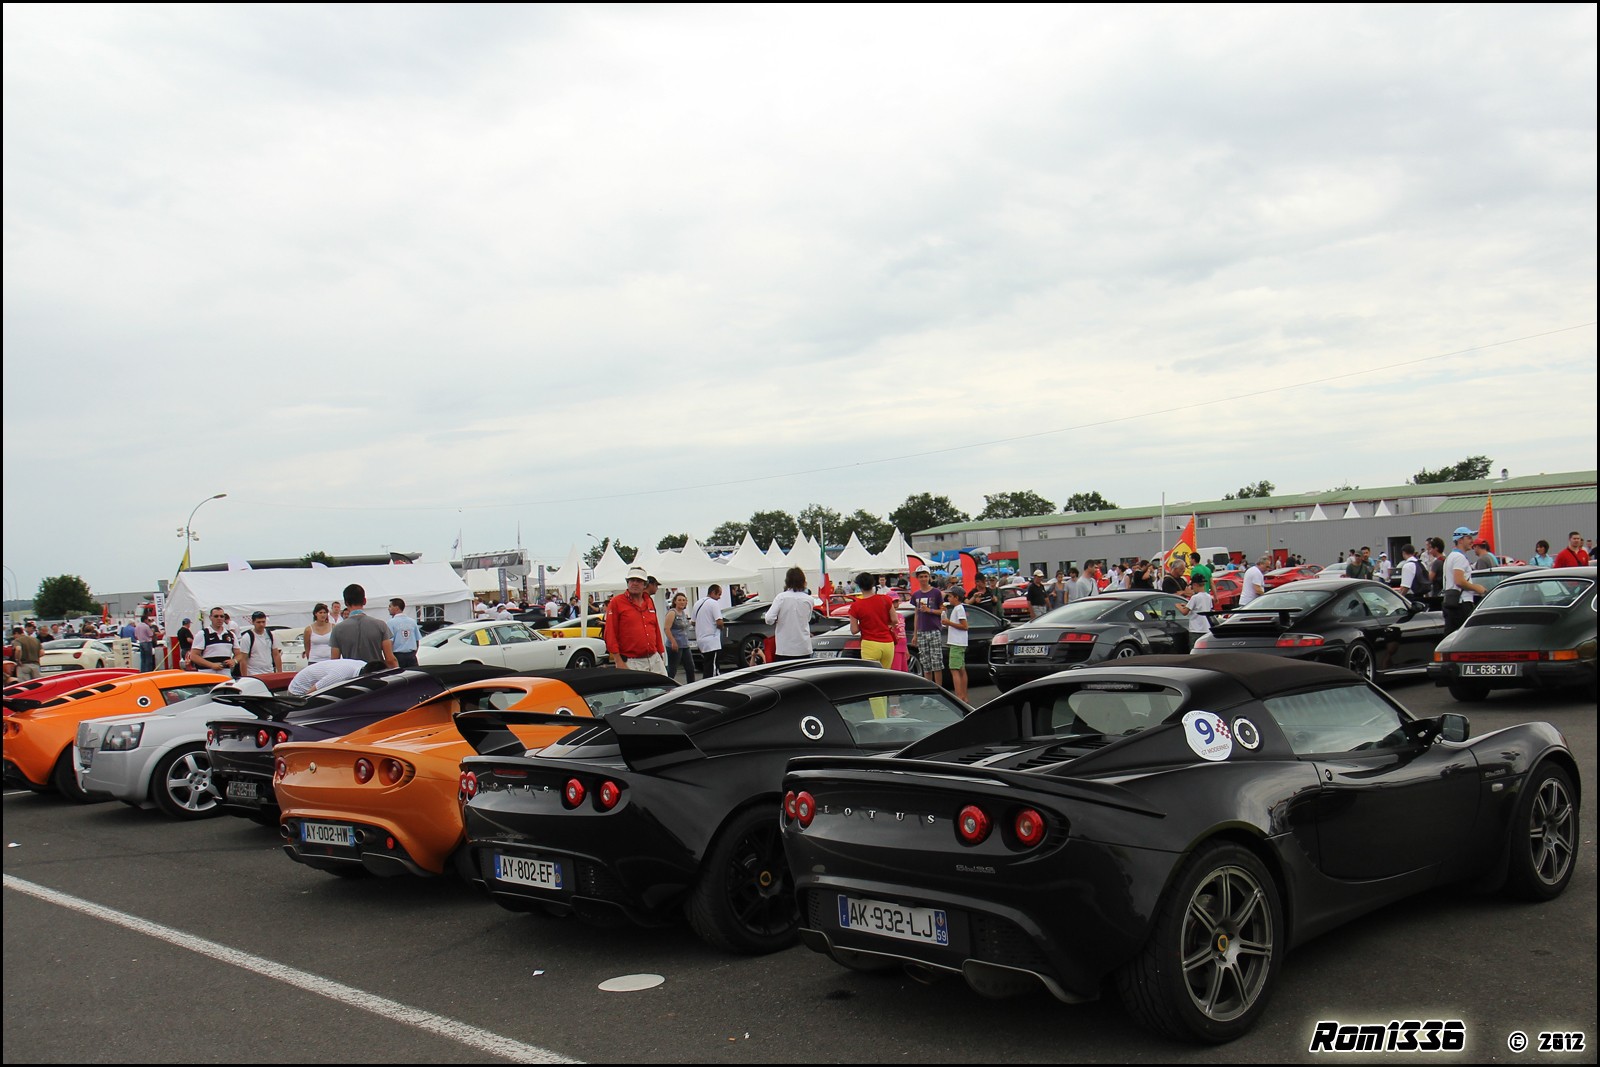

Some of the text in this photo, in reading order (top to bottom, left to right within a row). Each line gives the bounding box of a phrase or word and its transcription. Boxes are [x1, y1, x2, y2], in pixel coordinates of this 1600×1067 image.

[1465, 665, 1513, 675] AL-636-KV
[1194, 718, 1215, 745] 9
[824, 806, 935, 823] LOTUS
[306, 826, 349, 843] AY-002-HW
[502, 858, 553, 884] AY-802-EF
[850, 902, 933, 938] AK-932-LJ
[937, 929, 947, 942] 59
